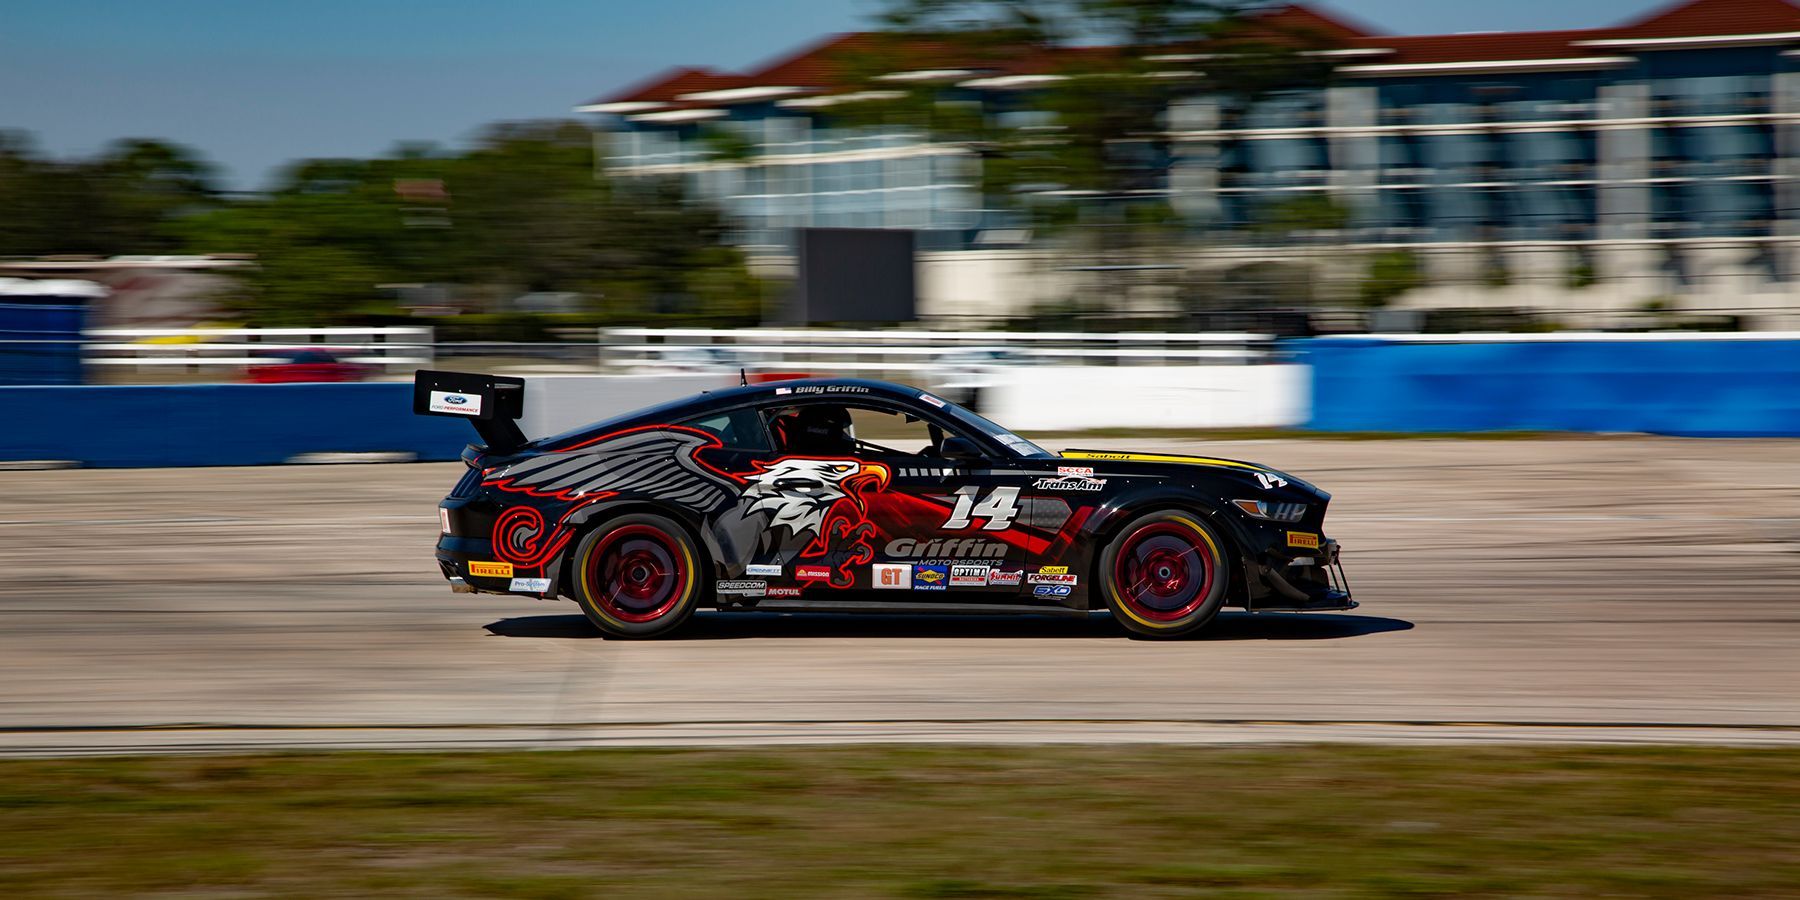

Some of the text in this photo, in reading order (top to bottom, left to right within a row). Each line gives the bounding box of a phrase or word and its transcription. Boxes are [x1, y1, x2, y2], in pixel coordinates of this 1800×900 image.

[795, 385, 869, 394] Billy Griffin
[1254, 472, 1288, 490] 14
[942, 485, 1021, 530] 14
[884, 538, 1009, 558] Griffin
[470, 563, 512, 576] PIRELLI
[953, 568, 986, 576] OPTIMA
[881, 568, 902, 585] GT
[916, 573, 945, 582] SUNOCO
[1029, 574, 1076, 583] FORGELINE
[768, 588, 800, 596] MOTUL
